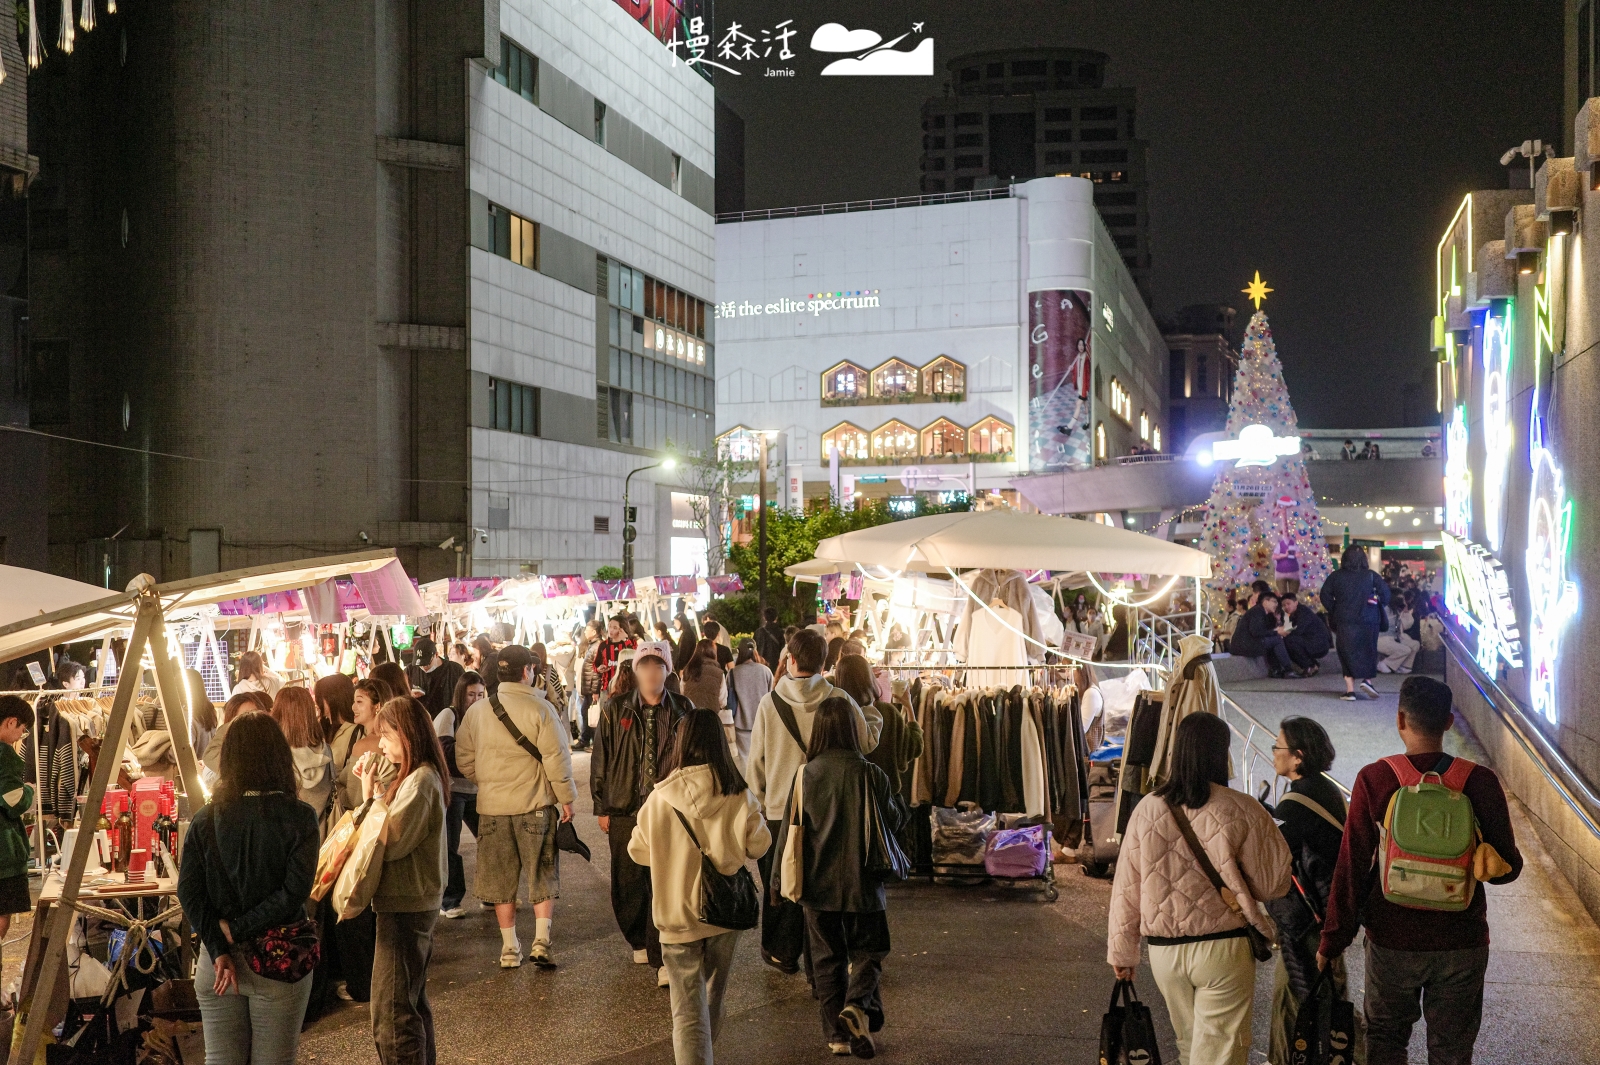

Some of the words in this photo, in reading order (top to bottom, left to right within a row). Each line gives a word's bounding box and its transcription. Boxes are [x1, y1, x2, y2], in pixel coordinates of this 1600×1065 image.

[739, 300, 762, 316] the
[765, 298, 805, 314] eslite
[808, 295, 880, 316] spectrum
